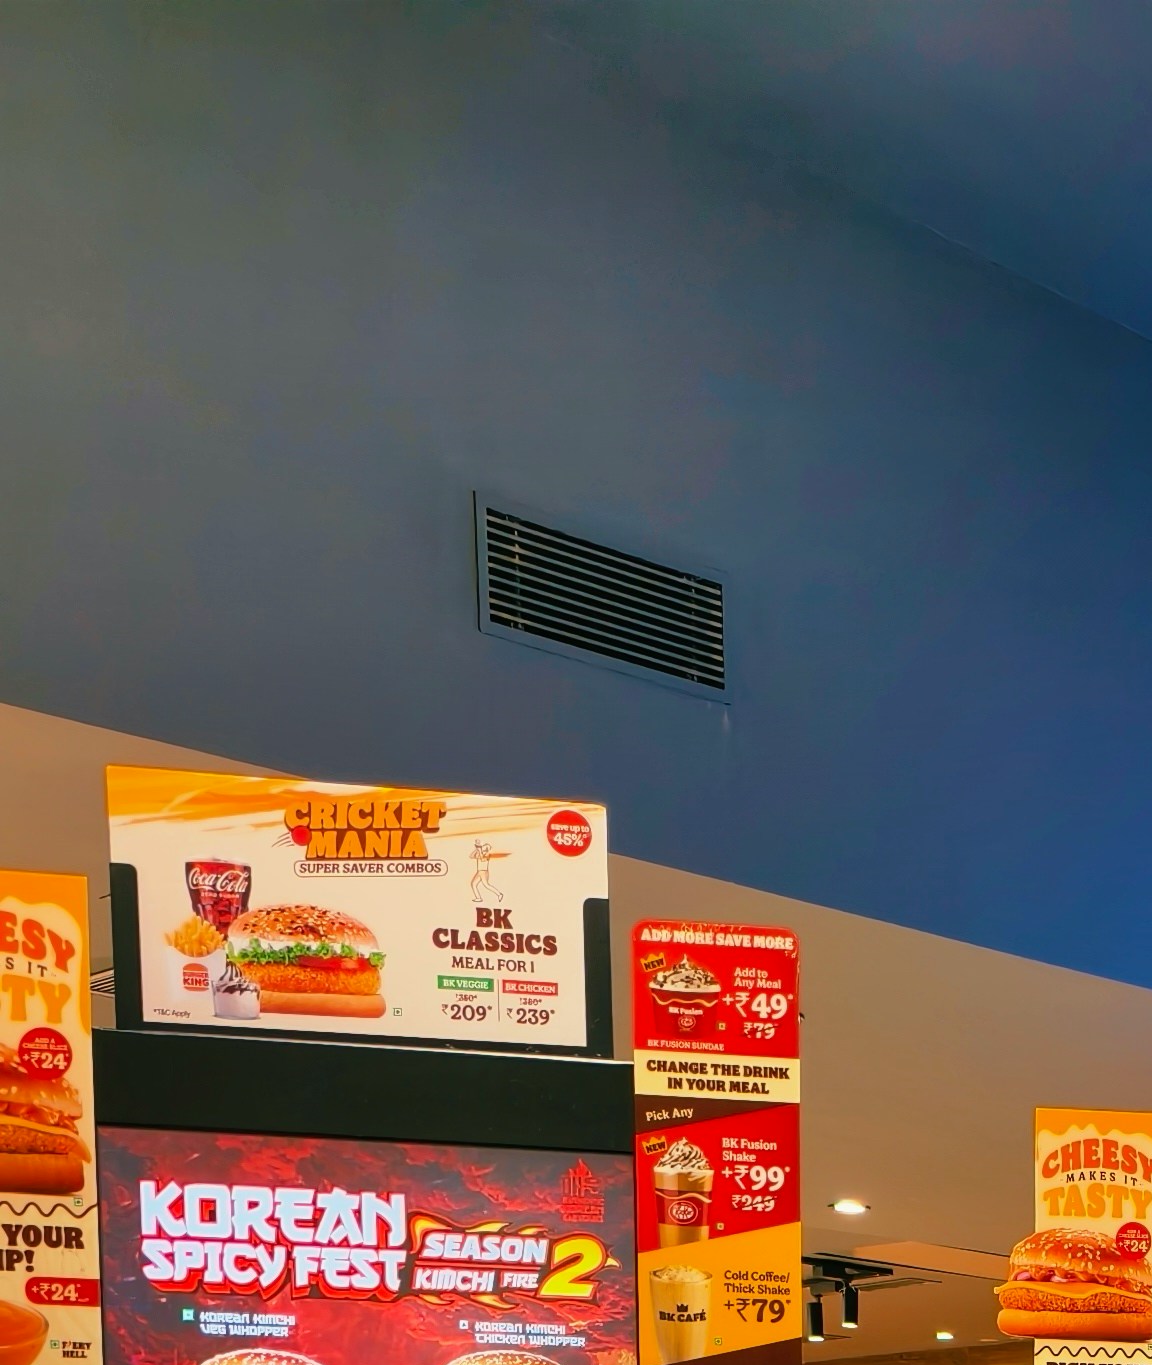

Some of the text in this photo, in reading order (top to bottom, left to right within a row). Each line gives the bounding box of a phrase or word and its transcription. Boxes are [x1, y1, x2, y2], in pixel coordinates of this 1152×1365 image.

[284, 801, 448, 833] CRICKET
[305, 830, 430, 859] MANIA
[299, 862, 442, 874] SUPER SAVER COMBOS
[188, 867, 249, 894] Coca-Cola
[476, 907, 513, 930] BK
[432, 928, 558, 956] CLASSICS
[641, 928, 794, 951] ADD MORE SAVE MORE
[451, 956, 495, 971] MEAL
[497, 959, 527, 973] FOR
[644, 957, 665, 971] NEW
[734, 967, 768, 979] Add to
[183, 978, 209, 987] KING
[443, 980, 489, 990] BK VEGGIE
[505, 983, 556, 994] BK CHICKEN
[733, 978, 782, 989] Any Meal
[647, 1040, 724, 1051] BK FUSION SUNDAE
[646, 1059, 790, 1080] CHANGE THE DRINK
[667, 1077, 770, 1095] IN YOUR MEAL
[646, 1108, 694, 1121] Pick Any
[722, 1137, 777, 1151] BK Fusion
[722, 1151, 757, 1163] Shake
[1065, 1170, 1138, 1186] MAKES IT
[1043, 1182, 1152, 1219] TASTY
[140, 1180, 406, 1247] KOREAN
[2, 1224, 85, 1250] YOUR
[142, 1238, 406, 1292] SPICY FEST
[420, 1232, 606, 1299] SEASON 2
[413, 1266, 539, 1292] KIMCHI FIRE
[724, 1270, 790, 1284] Cold Coffee/
[724, 1283, 791, 1296] Thick Shake
[659, 1309, 707, 1323] BK CAFÉ
